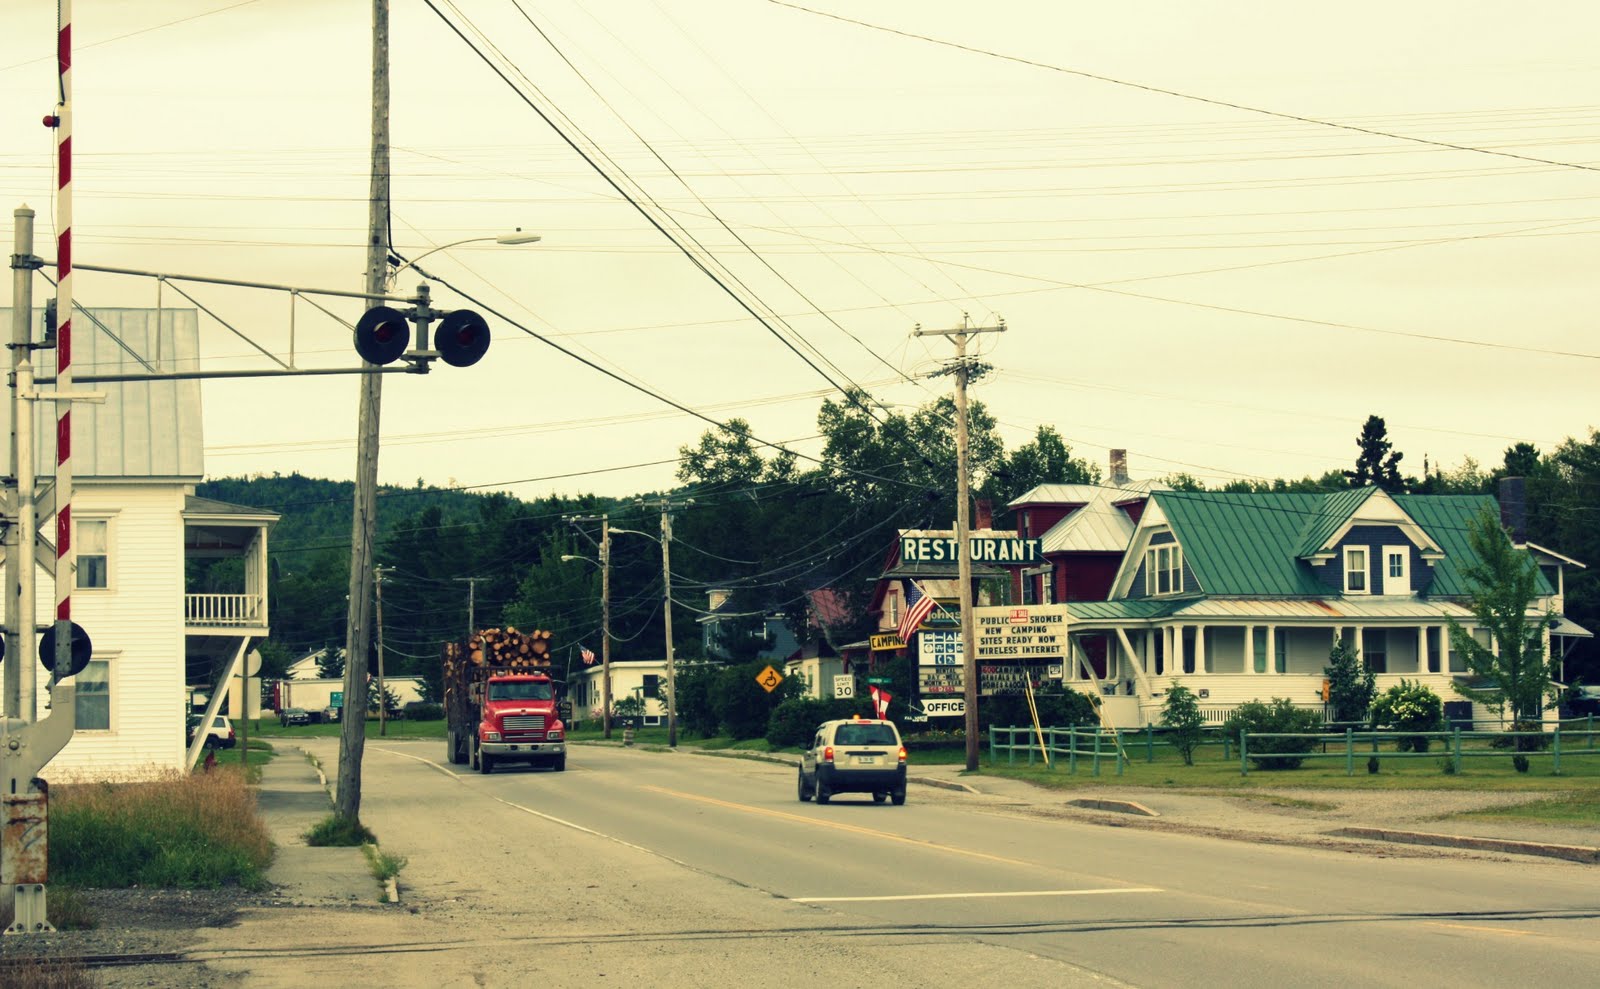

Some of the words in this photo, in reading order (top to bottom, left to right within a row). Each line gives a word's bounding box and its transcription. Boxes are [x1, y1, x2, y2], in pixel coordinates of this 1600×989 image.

[904, 539, 1037, 560] RESTURANT
[985, 627, 1002, 635] NEW
[1011, 626, 1047, 634] CAMPING
[980, 637, 1003, 645] SITES
[1007, 636, 1032, 644] READY
[979, 646, 1018, 655] WIRELESS
[1022, 645, 1060, 653] INTERNET
[836, 687, 852, 696] 30
[927, 703, 964, 712] OFFICE
